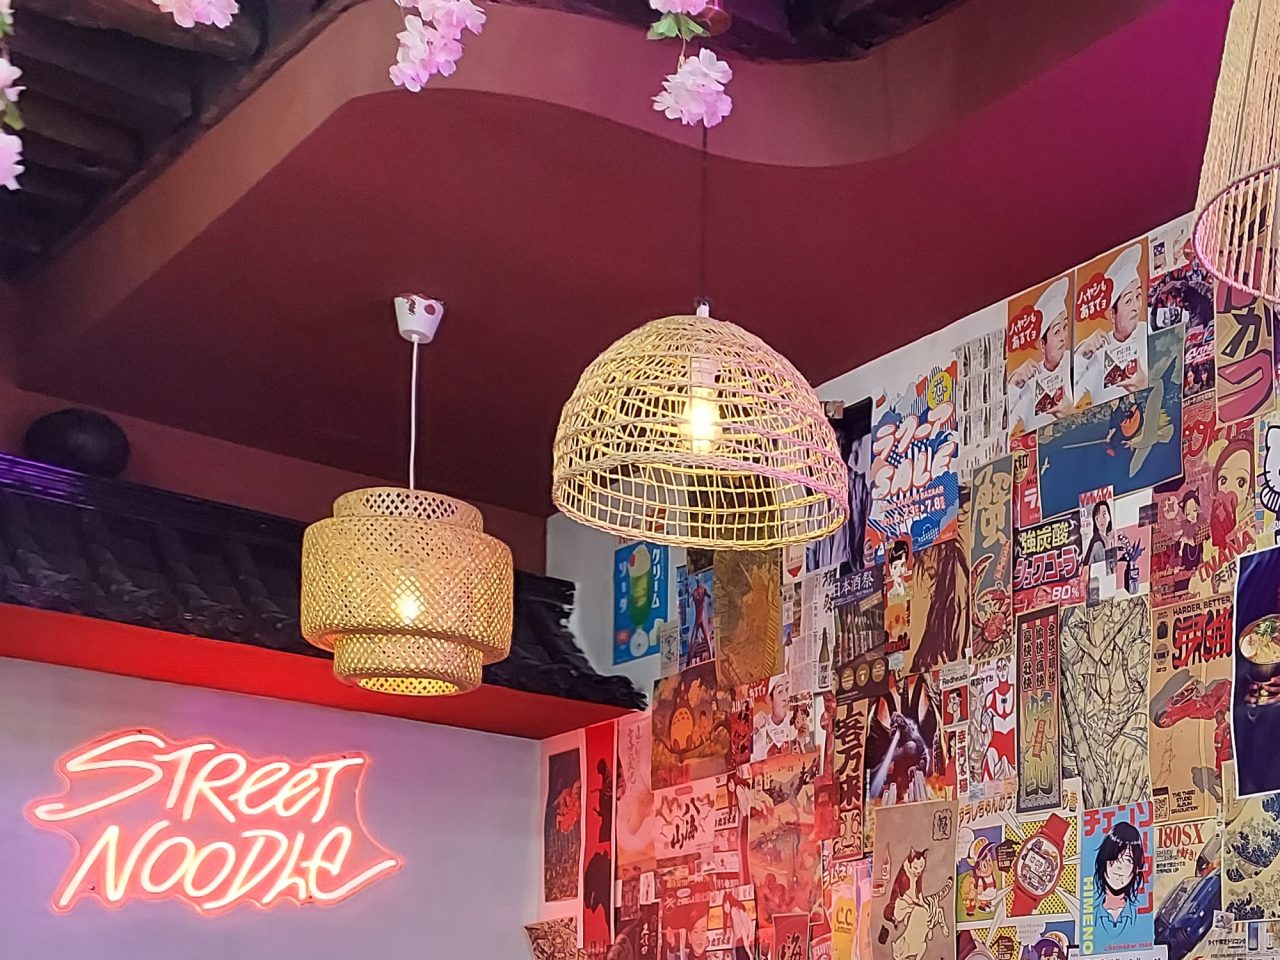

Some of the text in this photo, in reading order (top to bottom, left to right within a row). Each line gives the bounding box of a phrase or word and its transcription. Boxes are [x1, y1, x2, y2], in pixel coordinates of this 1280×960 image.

[1019, 521, 1071, 554] 強炭酸
[651, 548, 660, 608] クリーム
[832, 572, 875, 598] 日本酒祭
[942, 673, 968, 685] Redheads
[1156, 823, 1206, 849] 180SX
[1083, 877, 1094, 954] HIMENO
